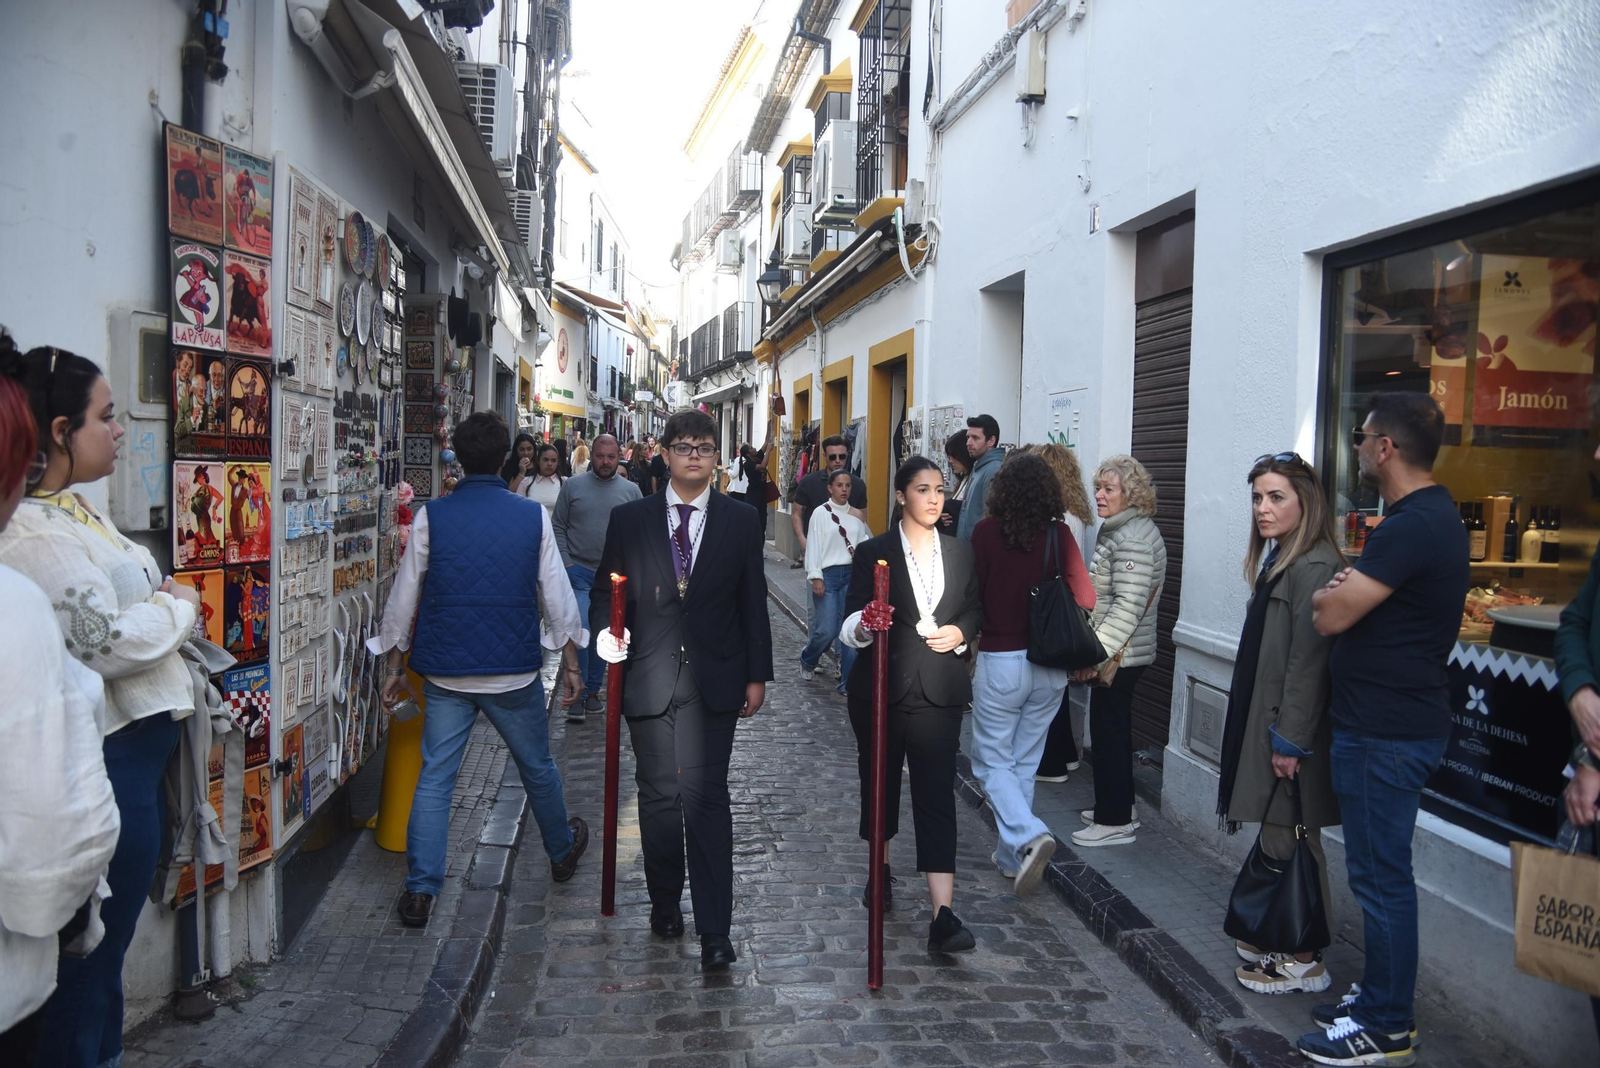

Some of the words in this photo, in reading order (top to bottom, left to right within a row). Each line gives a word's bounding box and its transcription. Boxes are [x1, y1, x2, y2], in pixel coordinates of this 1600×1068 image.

[1497, 386, 1568, 411] Jamón
[199, 549, 220, 559] CAMPOS
[1463, 716, 1475, 729] DE
[1476, 720, 1488, 733] LA
[1490, 724, 1528, 746] DEHESA
[1447, 760, 1474, 776] PROPIA
[1481, 772, 1513, 791] IBERIAN
[1515, 784, 1557, 807] PRODUCT
[1536, 894, 1595, 927] SABOR
